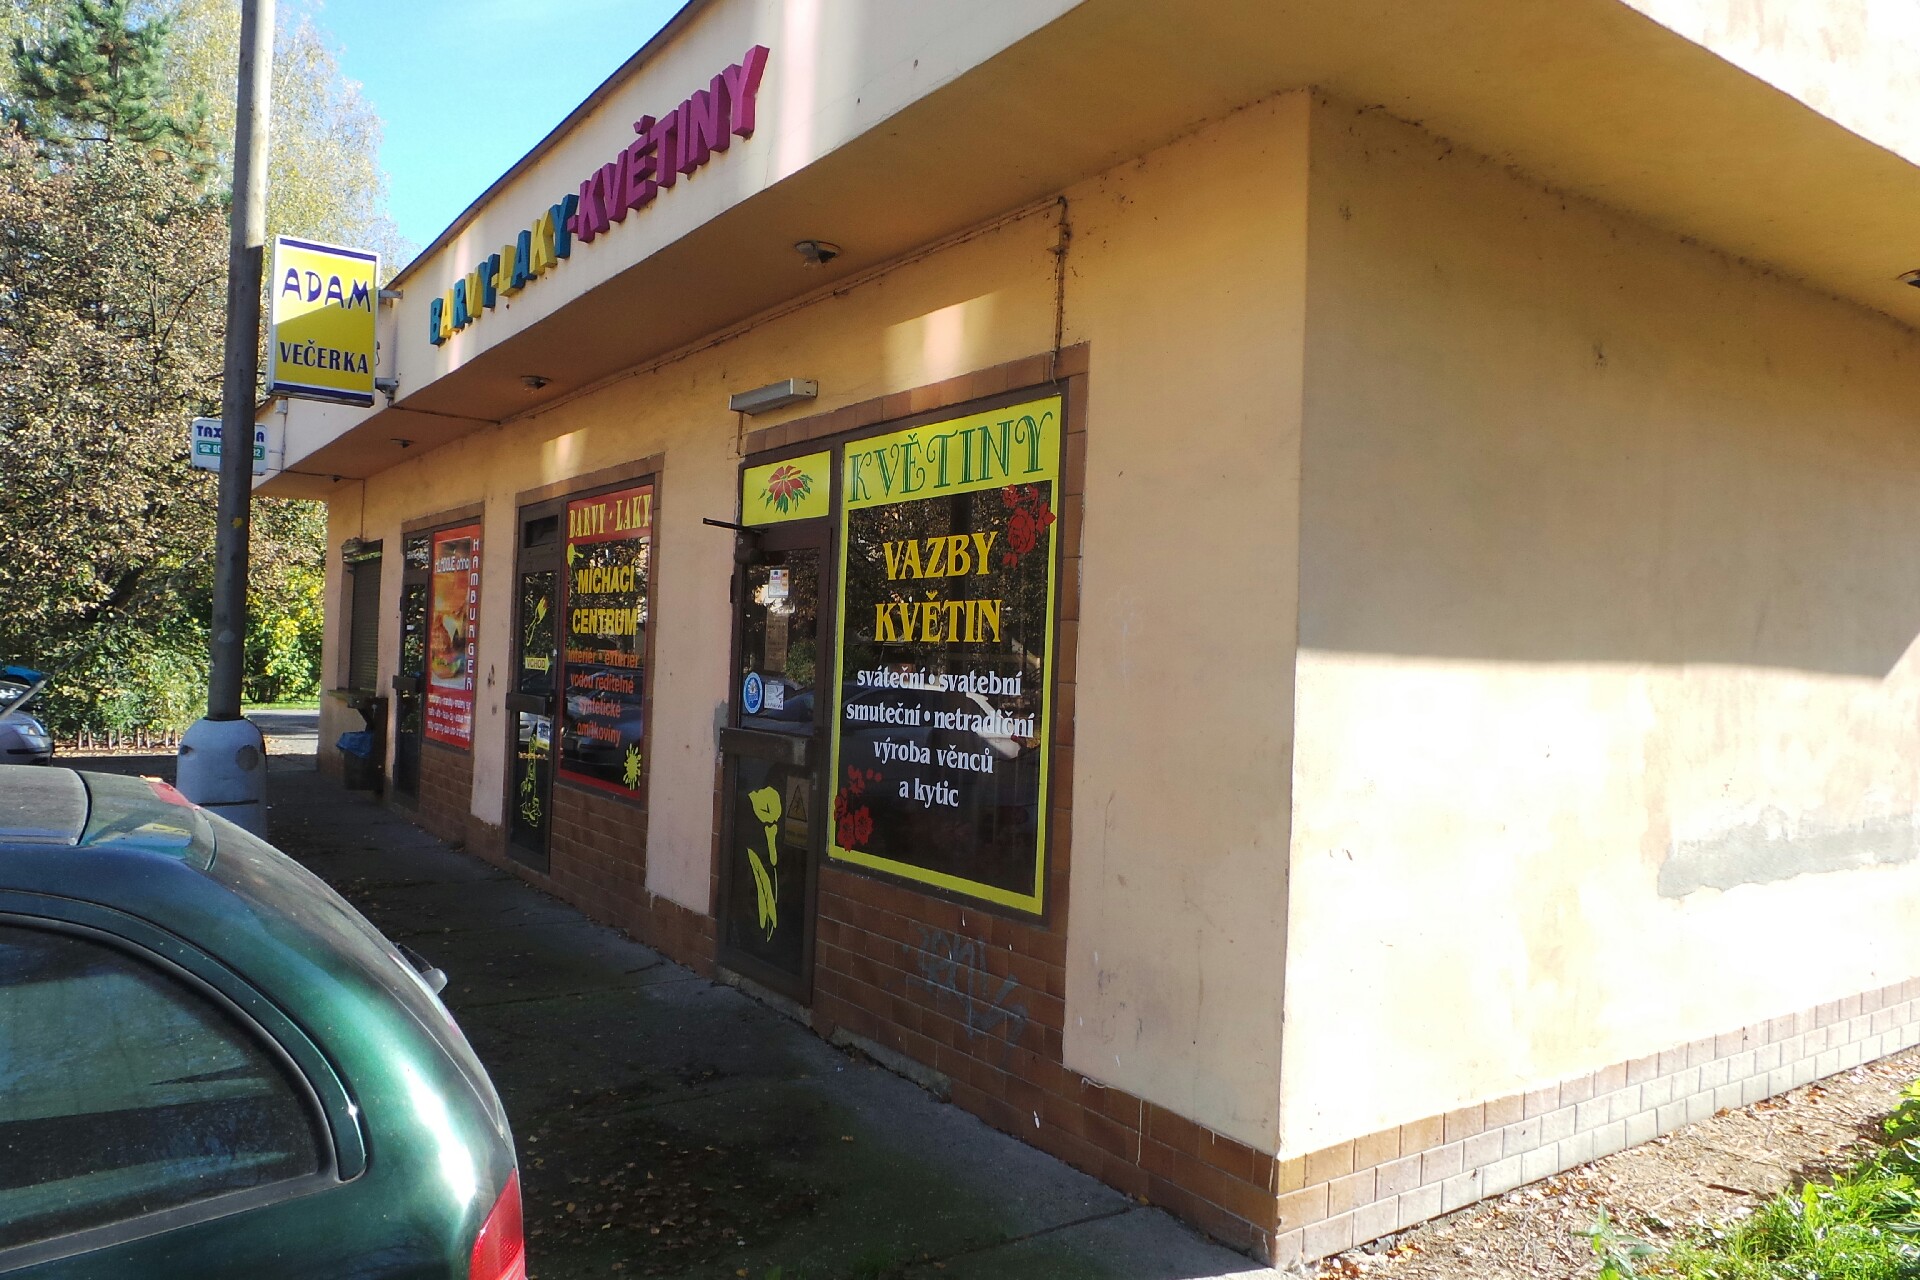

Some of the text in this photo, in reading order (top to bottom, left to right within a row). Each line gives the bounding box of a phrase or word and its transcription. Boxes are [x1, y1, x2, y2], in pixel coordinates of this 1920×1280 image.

[282, 267, 371, 313] ADAM
[280, 339, 369, 375] VEČERKA
[847, 411, 1053, 503] KVĚTINY
[569, 493, 652, 539] BARVY LAKY
[882, 531, 998, 580] VAZBY
[577, 557, 637, 594] MÍCHACÍ
[572, 608, 638, 636] CENTRUM
[874, 589, 1002, 643] KVĚTIN
[527, 658, 546, 669] VCHOD
[856, 665, 1023, 696] sváteční svatební
[846, 701, 1035, 738] smuteční netradiční
[873, 737, 993, 774] výroba věnců
[899, 778, 959, 809] a kytic
